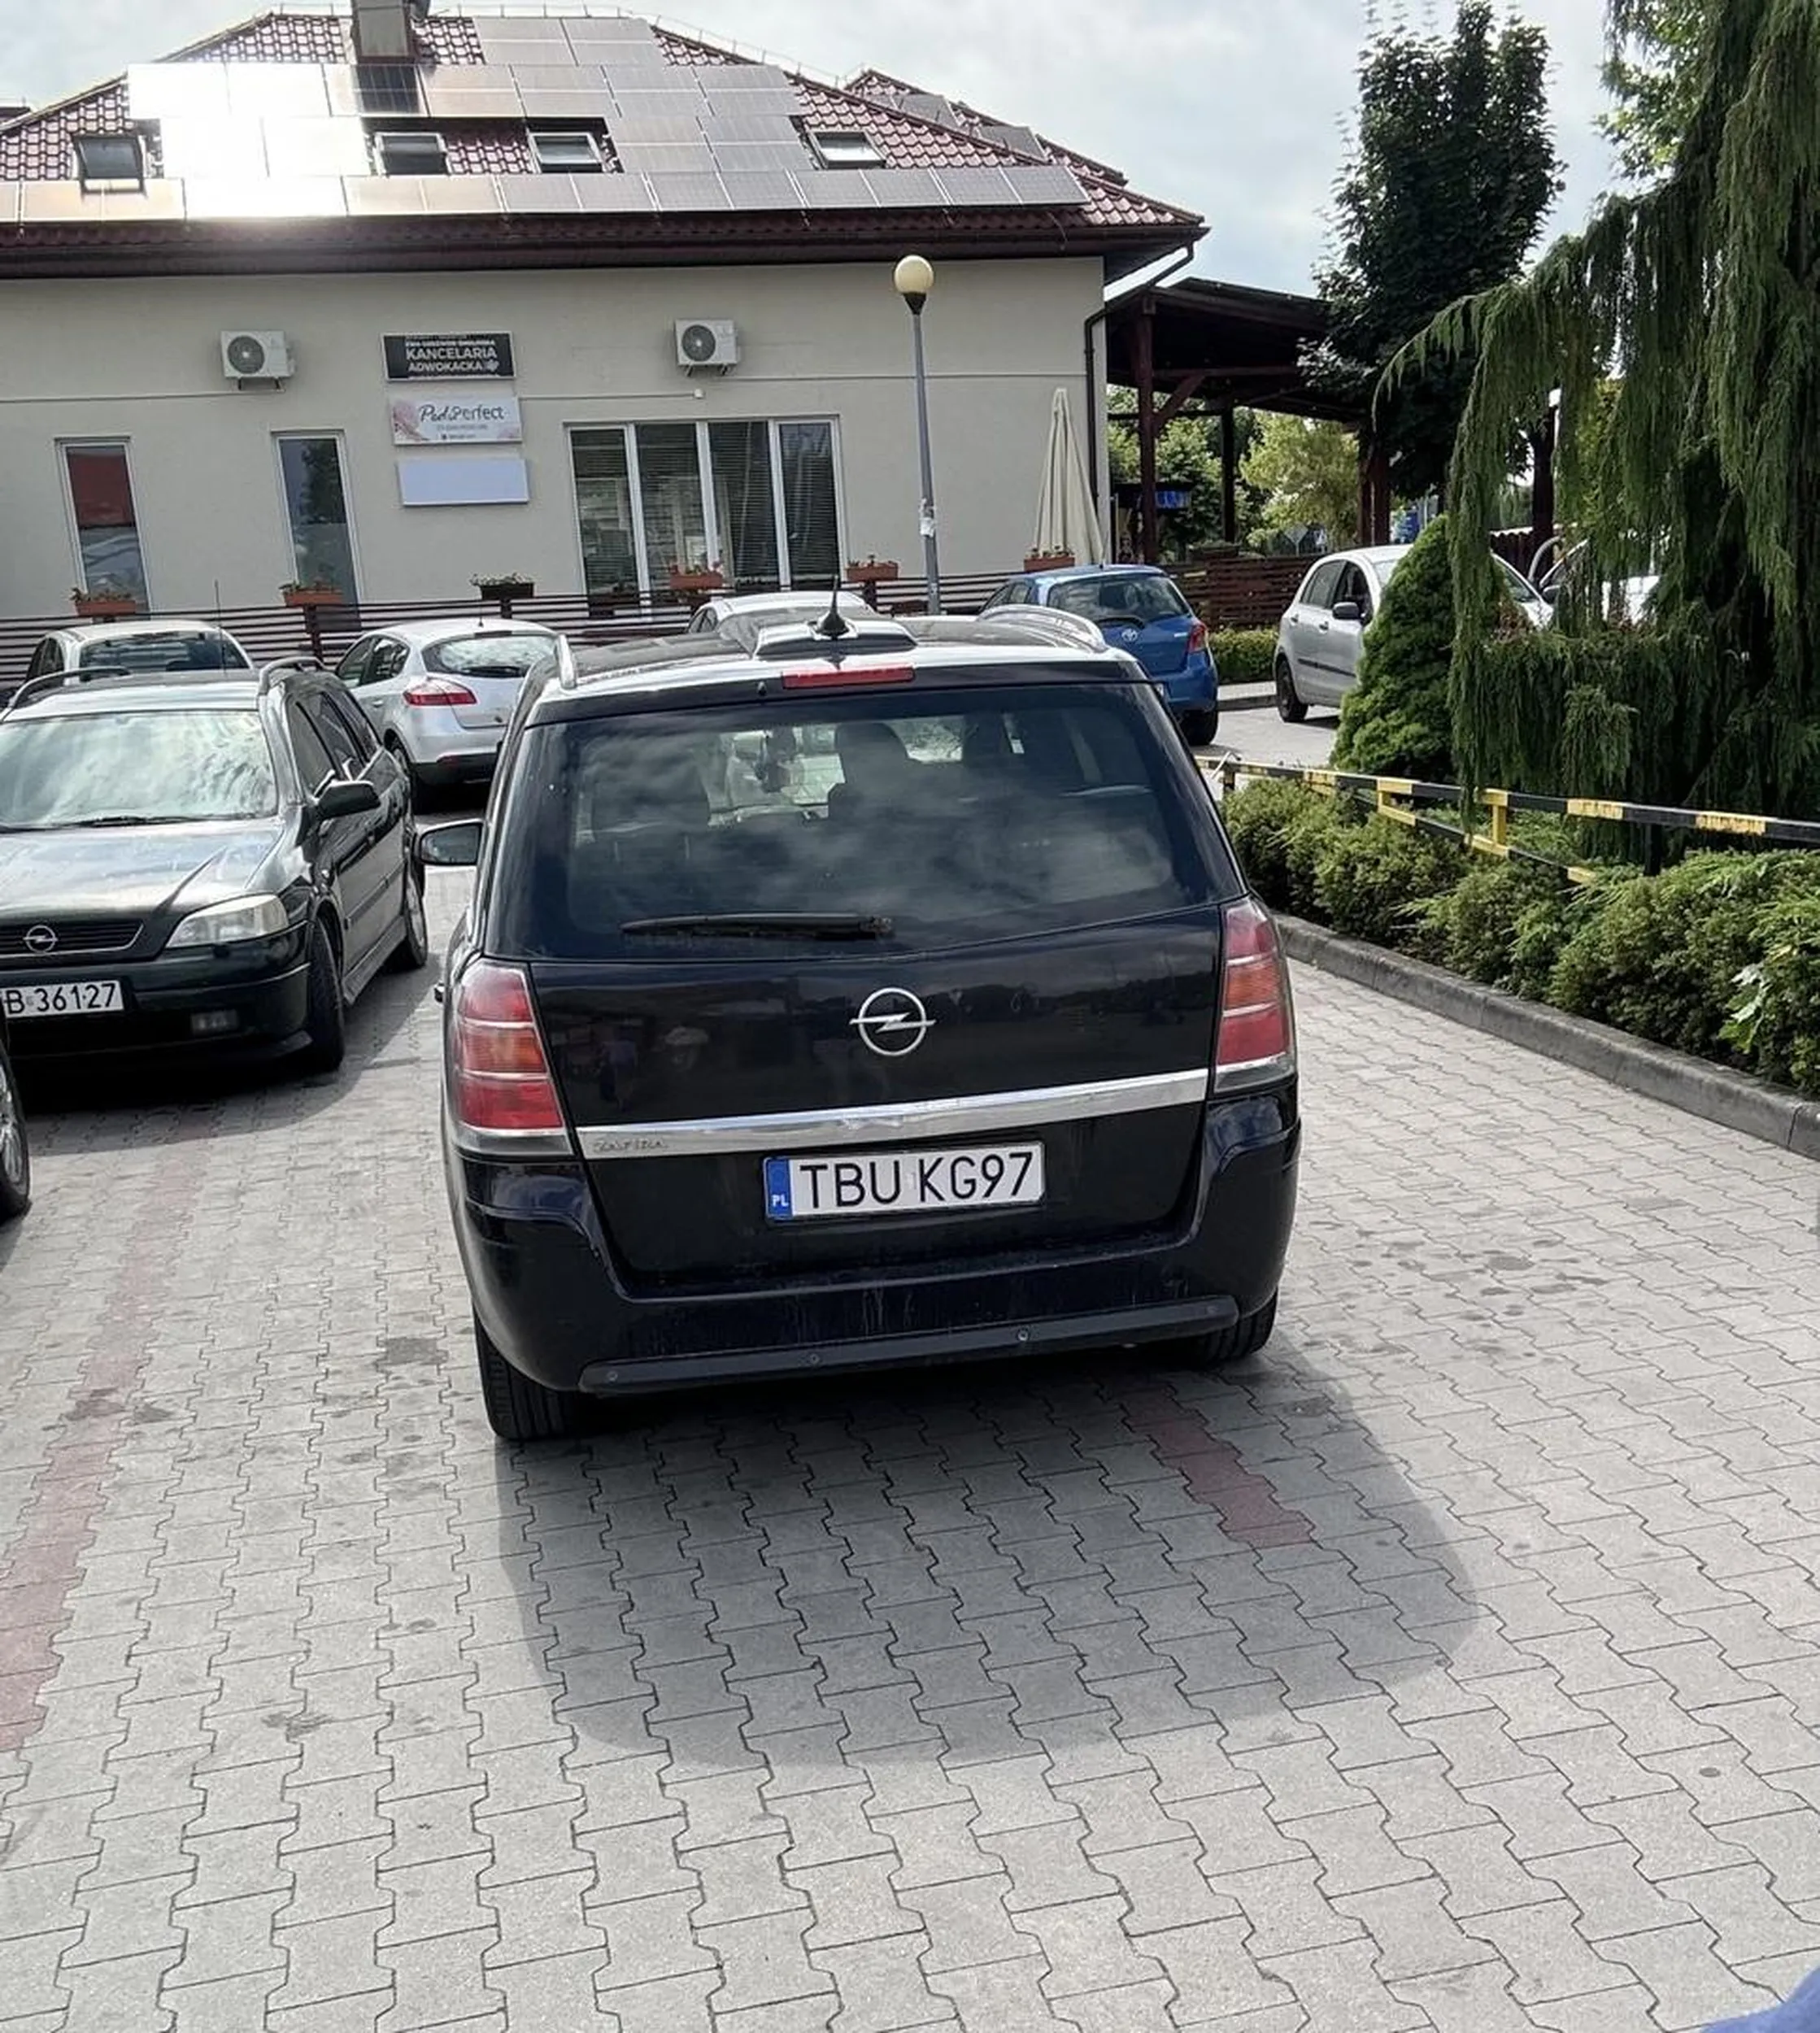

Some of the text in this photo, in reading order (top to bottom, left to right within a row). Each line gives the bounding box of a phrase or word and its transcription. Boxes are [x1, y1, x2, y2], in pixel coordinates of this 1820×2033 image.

[406, 347, 498, 360] KANCELARIA
[408, 360, 483, 372] ADWOKACKA
[34, 983, 115, 1012] 36127
[799, 1151, 1034, 1209] TBU KG97
[772, 1194, 789, 1207] PL
